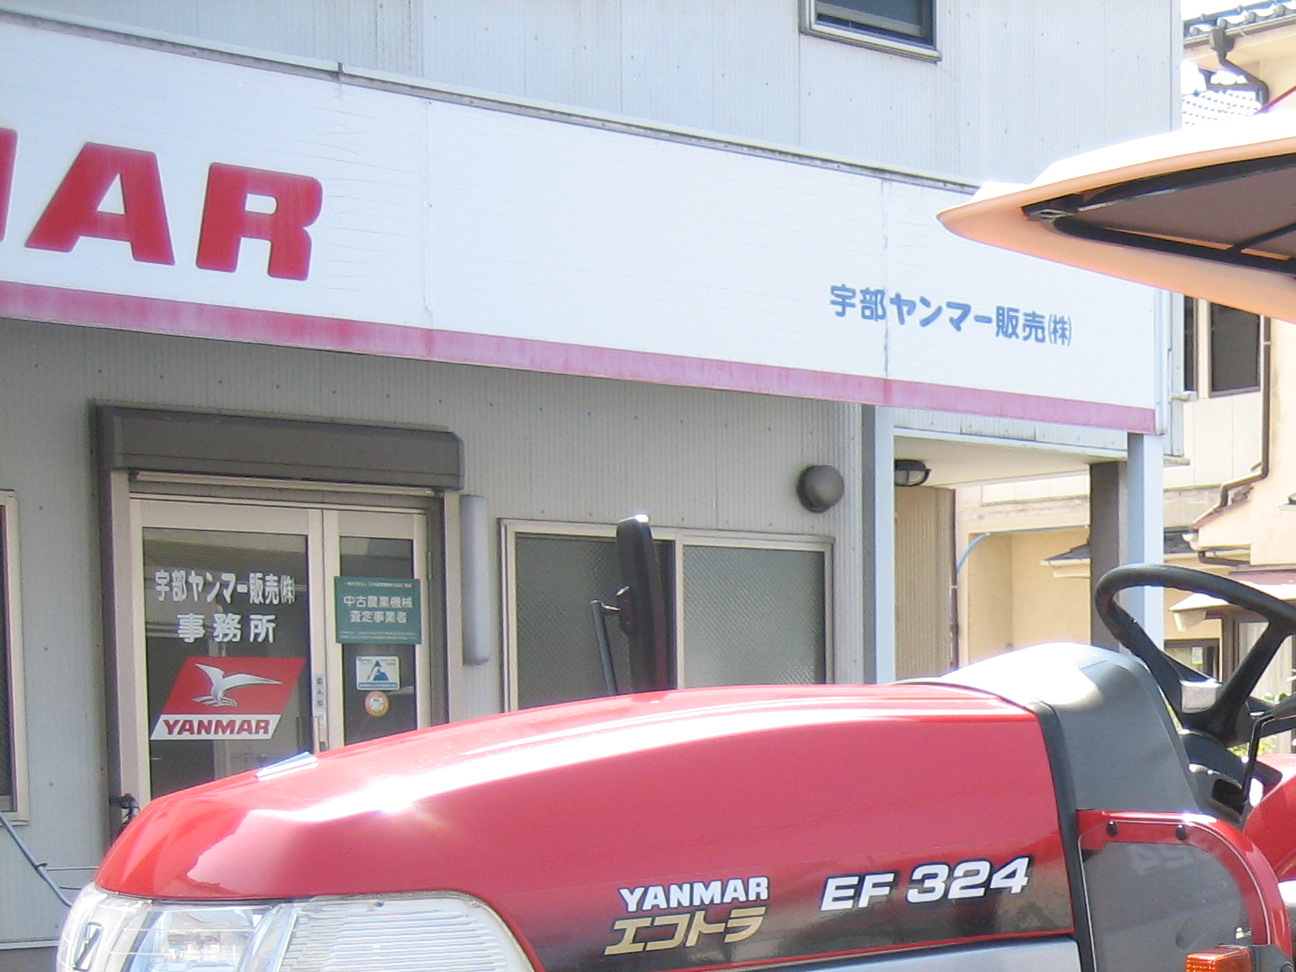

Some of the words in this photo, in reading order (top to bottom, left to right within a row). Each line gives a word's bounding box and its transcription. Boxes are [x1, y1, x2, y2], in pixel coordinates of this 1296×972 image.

[0, 128, 323, 281] AR
[177, 612, 276, 643] 事務所
[163, 719, 270, 735] YANMAR
[619, 876, 769, 913] YANMAR
[820, 872, 896, 911] EF
[906, 856, 1030, 904] 324
[603, 906, 768, 955] エコトラ
